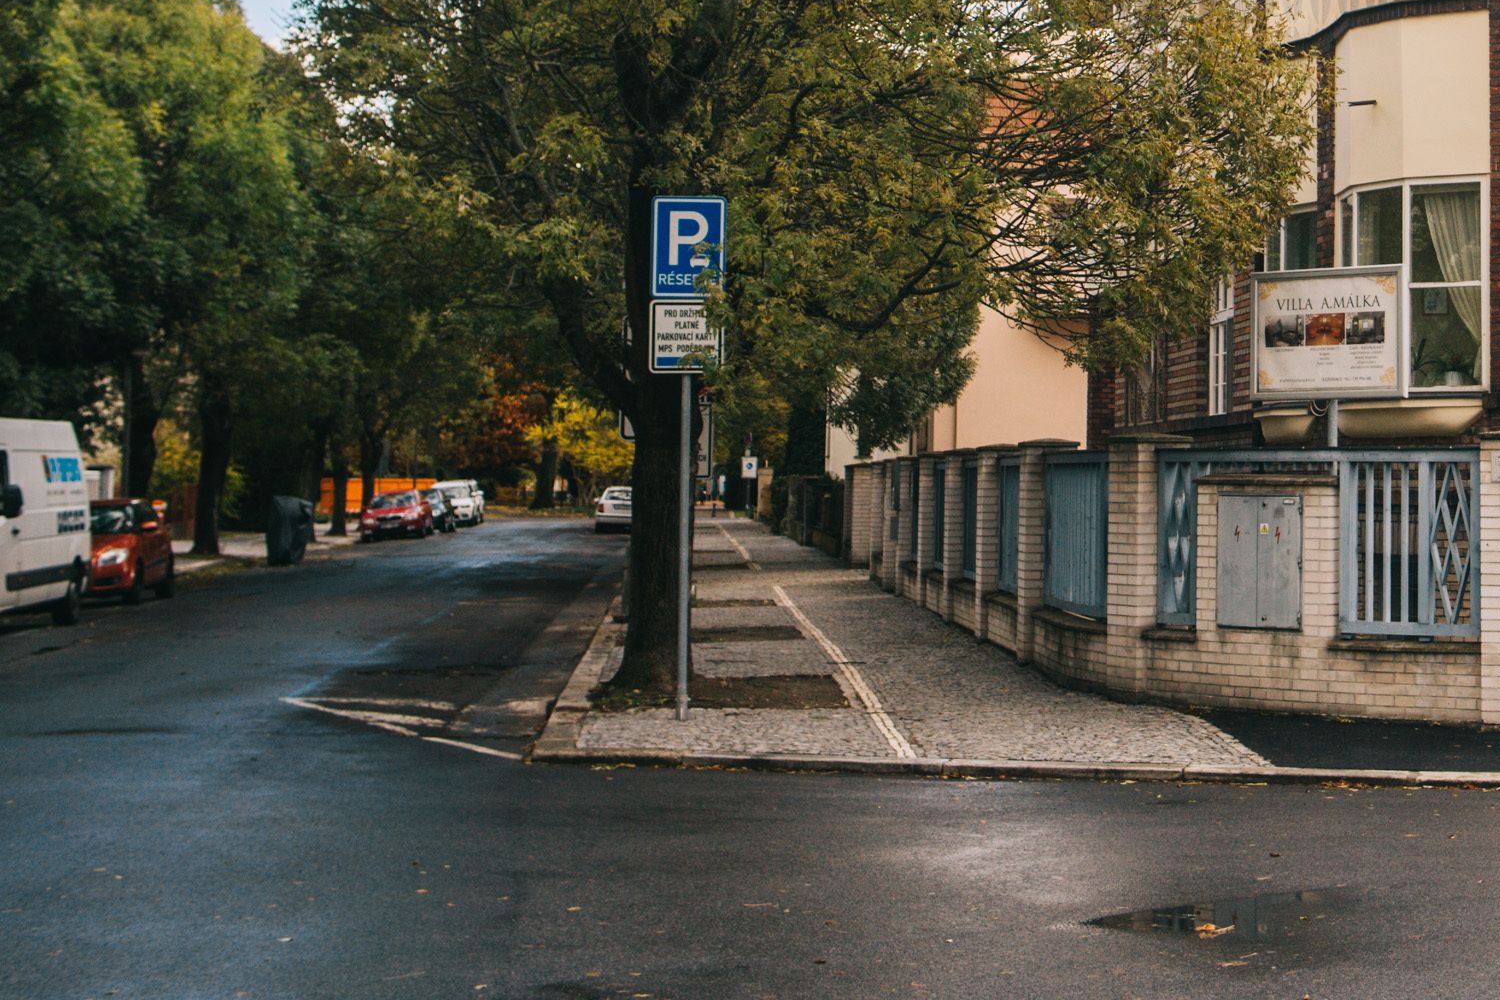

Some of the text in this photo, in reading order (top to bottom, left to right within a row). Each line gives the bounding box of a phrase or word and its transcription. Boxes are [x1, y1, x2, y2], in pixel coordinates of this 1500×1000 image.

[668, 210, 709, 266] P
[658, 270, 718, 286] RÉSE
[1276, 298, 1313, 311] VILLA
[664, 309, 678, 318] PRO
[674, 320, 700, 330] PLATNÉ
[656, 331, 717, 341] PARKOVACÍ KART
[658, 344, 673, 353] MPS
